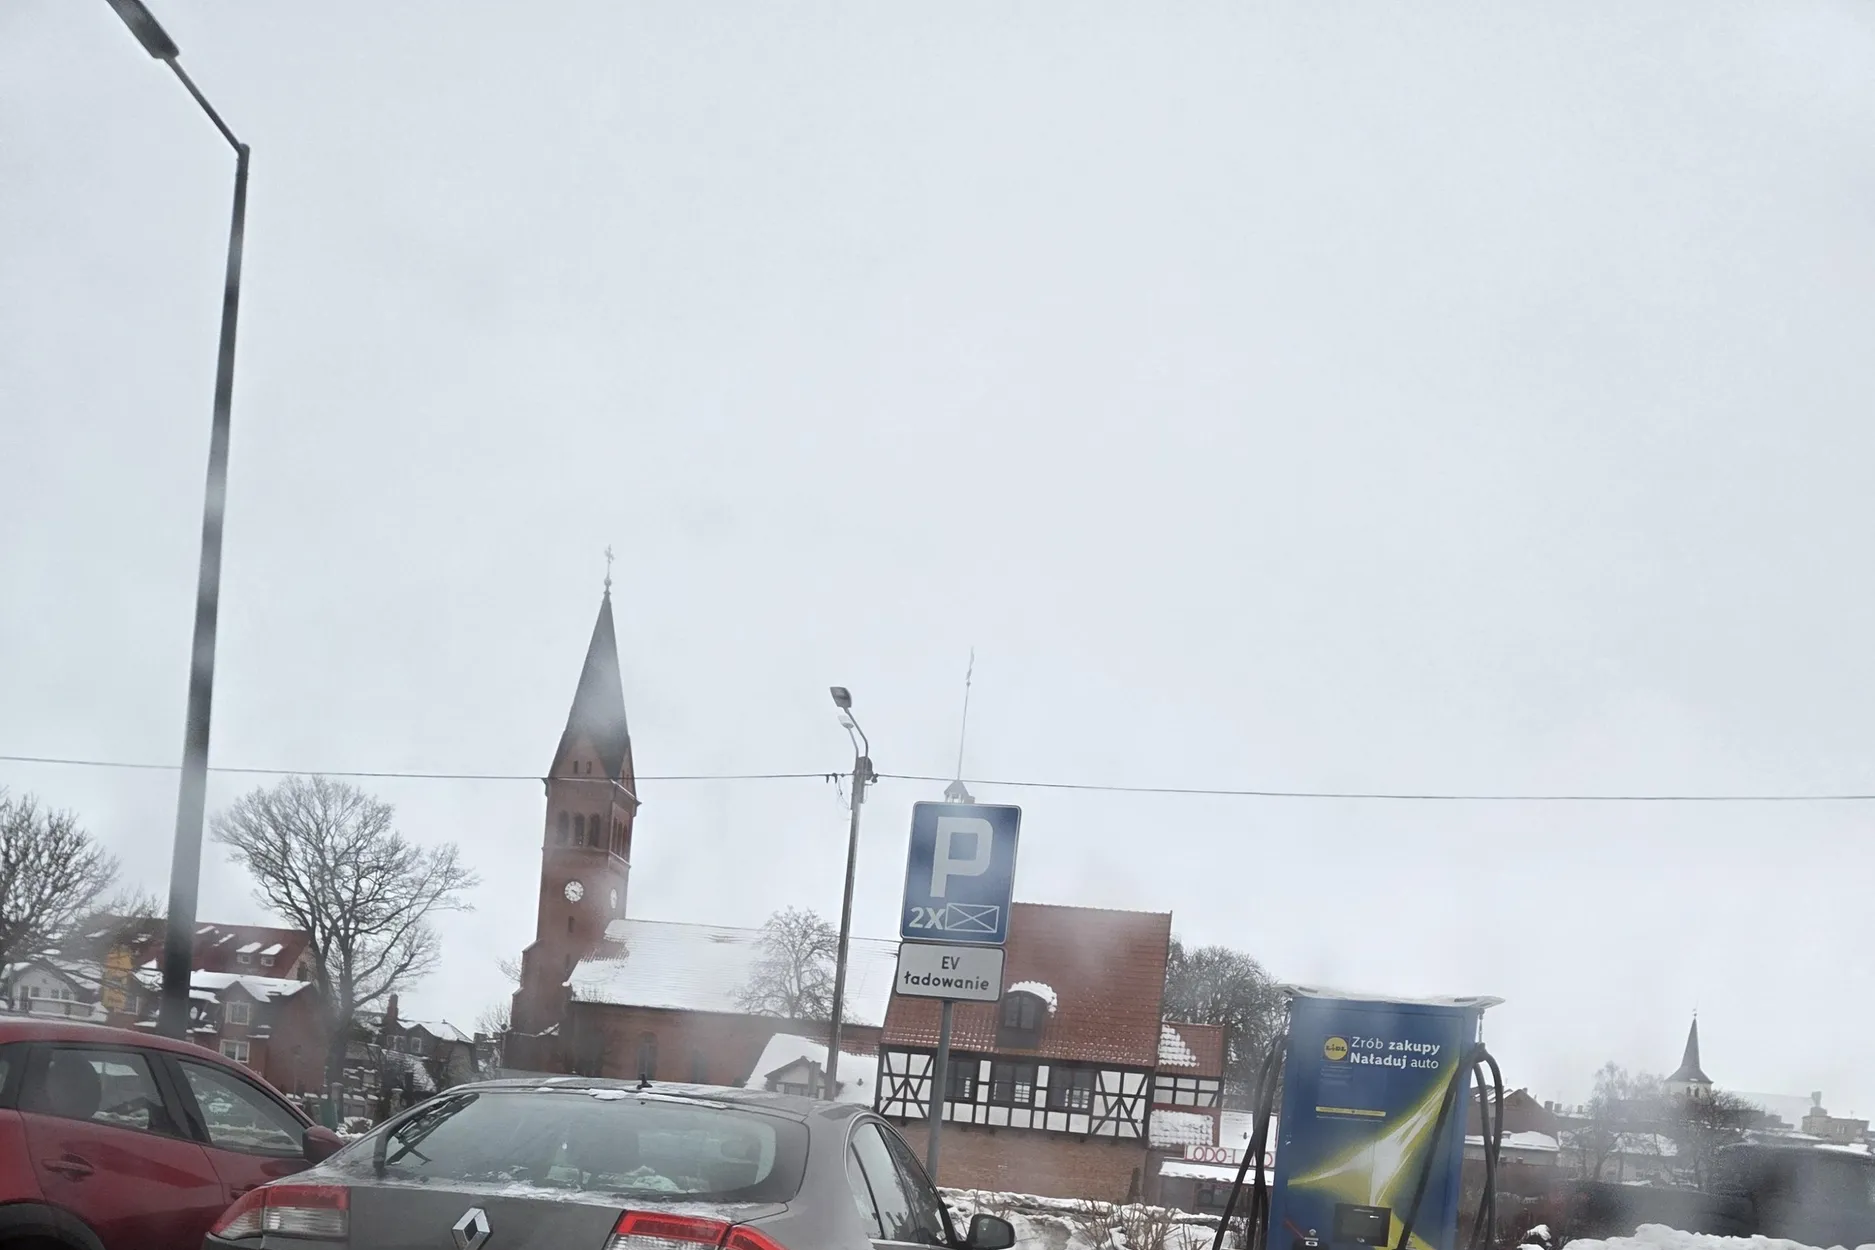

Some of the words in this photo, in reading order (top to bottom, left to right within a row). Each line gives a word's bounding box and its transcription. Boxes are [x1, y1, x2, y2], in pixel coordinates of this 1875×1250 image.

[930, 816, 994, 898] P
[941, 955, 961, 971] EV
[1351, 1036, 1384, 1050] Zrób
[1388, 1040, 1441, 1056] zakupy
[1350, 1052, 1408, 1070] Naładuj
[1410, 1058, 1439, 1069] auto
